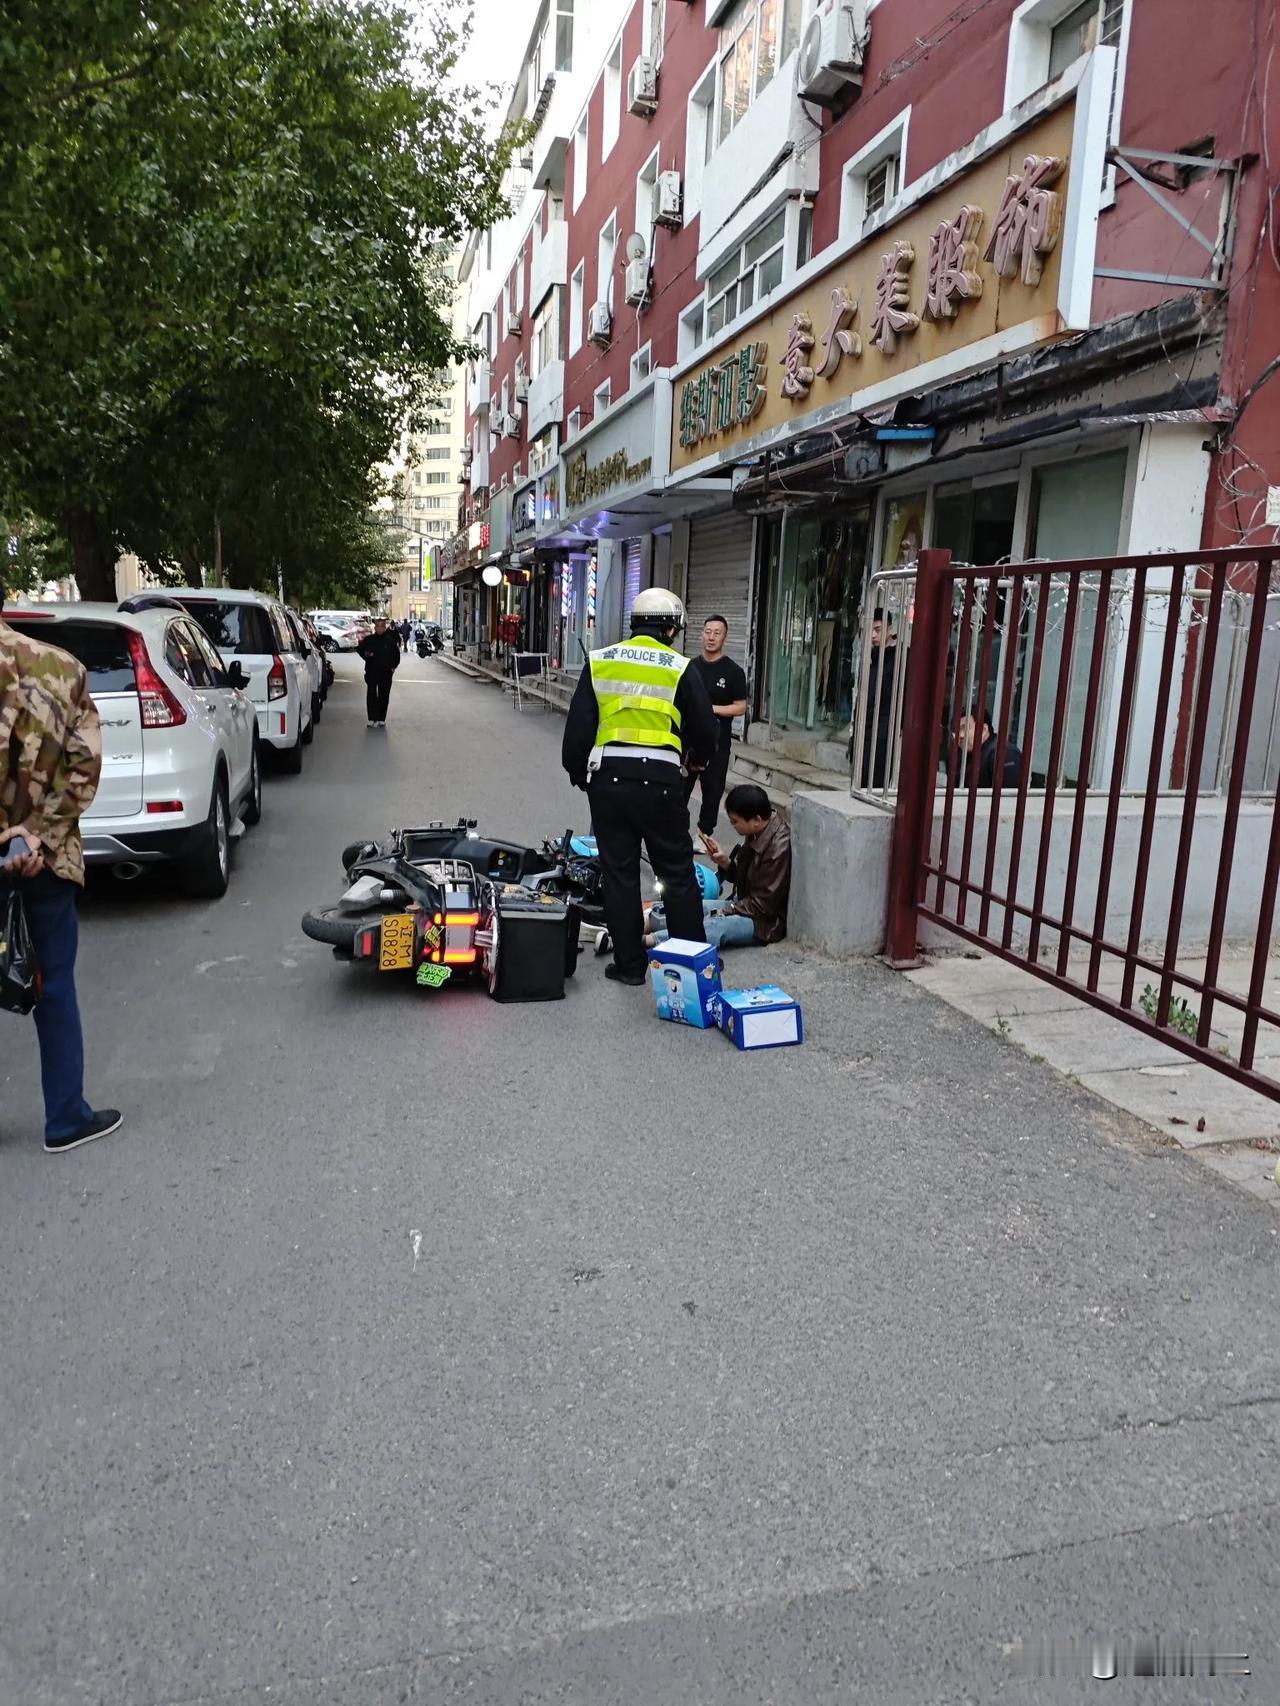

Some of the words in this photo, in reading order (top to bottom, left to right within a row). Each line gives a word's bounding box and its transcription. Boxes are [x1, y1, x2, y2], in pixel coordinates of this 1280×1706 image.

[680, 341, 768, 447] 维斯丽影
[602, 648, 619, 659] 警
[621, 648, 656, 662] POLICE
[659, 652, 675, 667] 察
[383, 919, 399, 967] S0828
